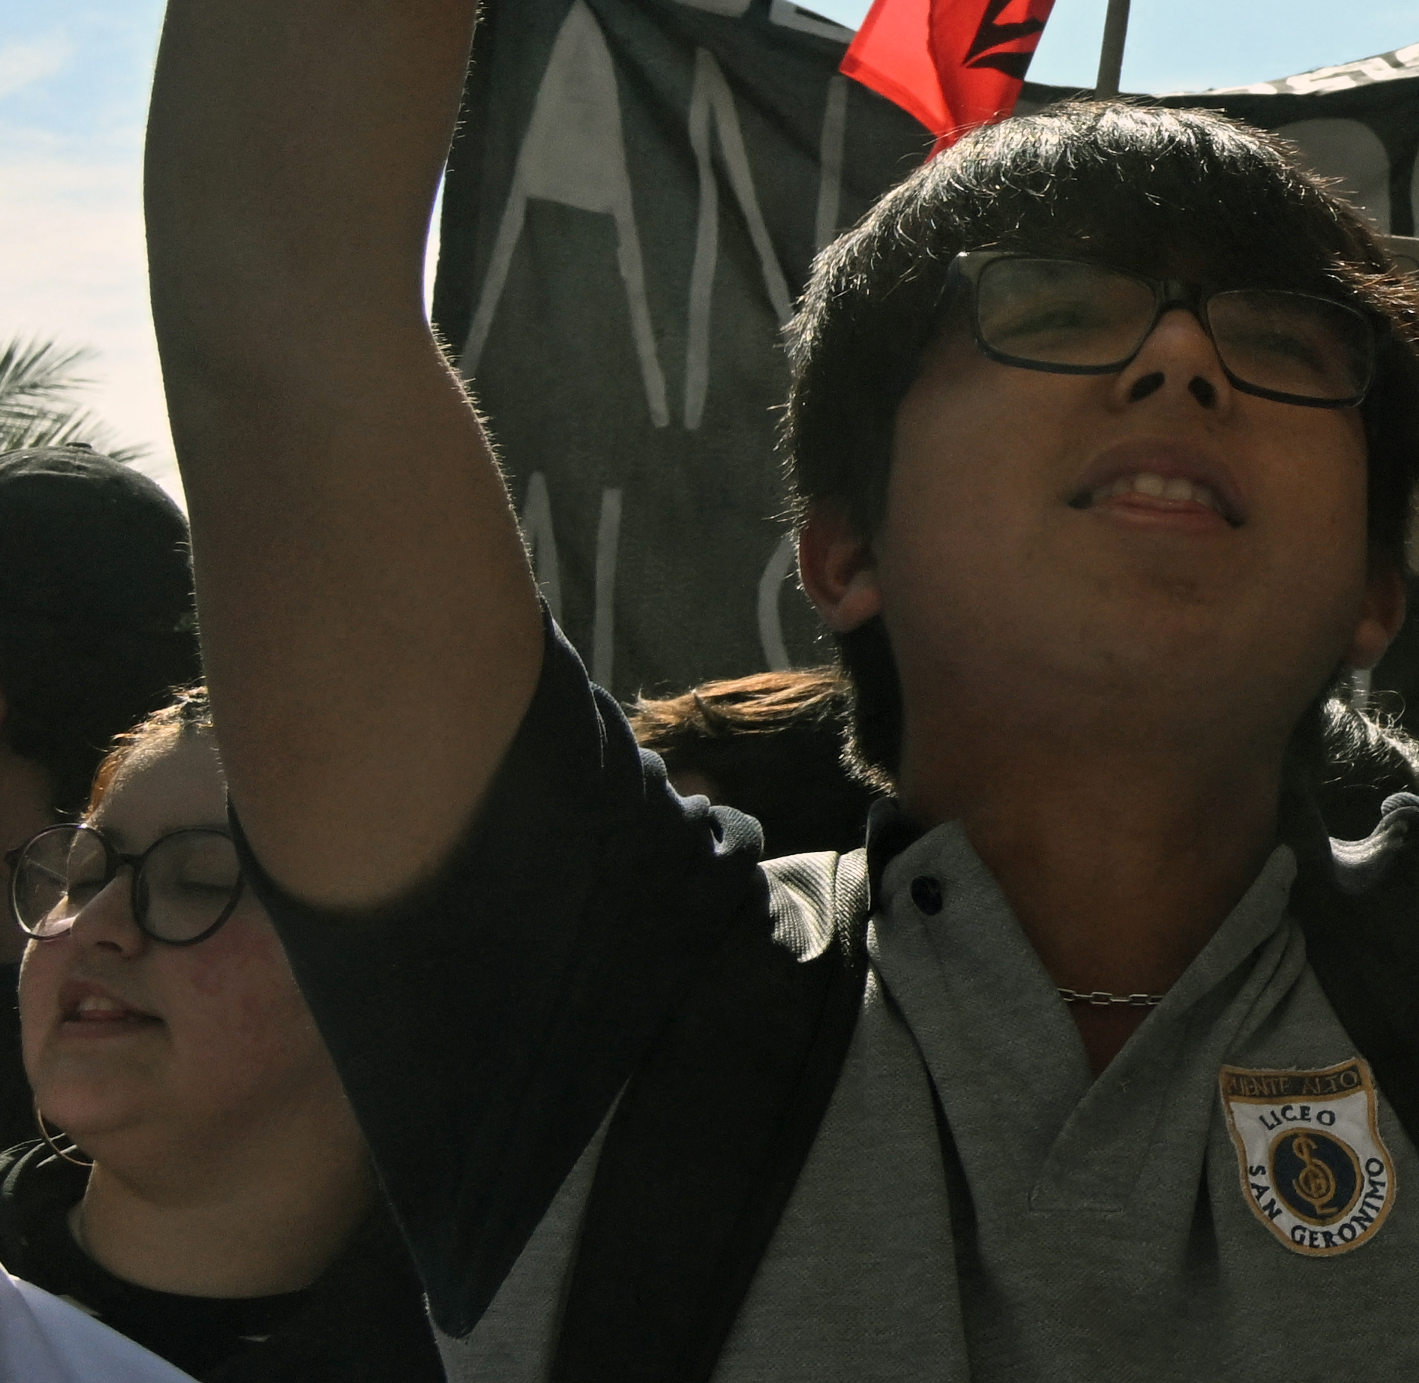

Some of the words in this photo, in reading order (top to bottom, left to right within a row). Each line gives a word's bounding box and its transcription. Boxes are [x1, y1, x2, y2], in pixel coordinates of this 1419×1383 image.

[1258, 1105, 1336, 1131] LICEO
[1249, 1164, 1284, 1222] SAN
[1291, 1157, 1387, 1249] GERONIMO
